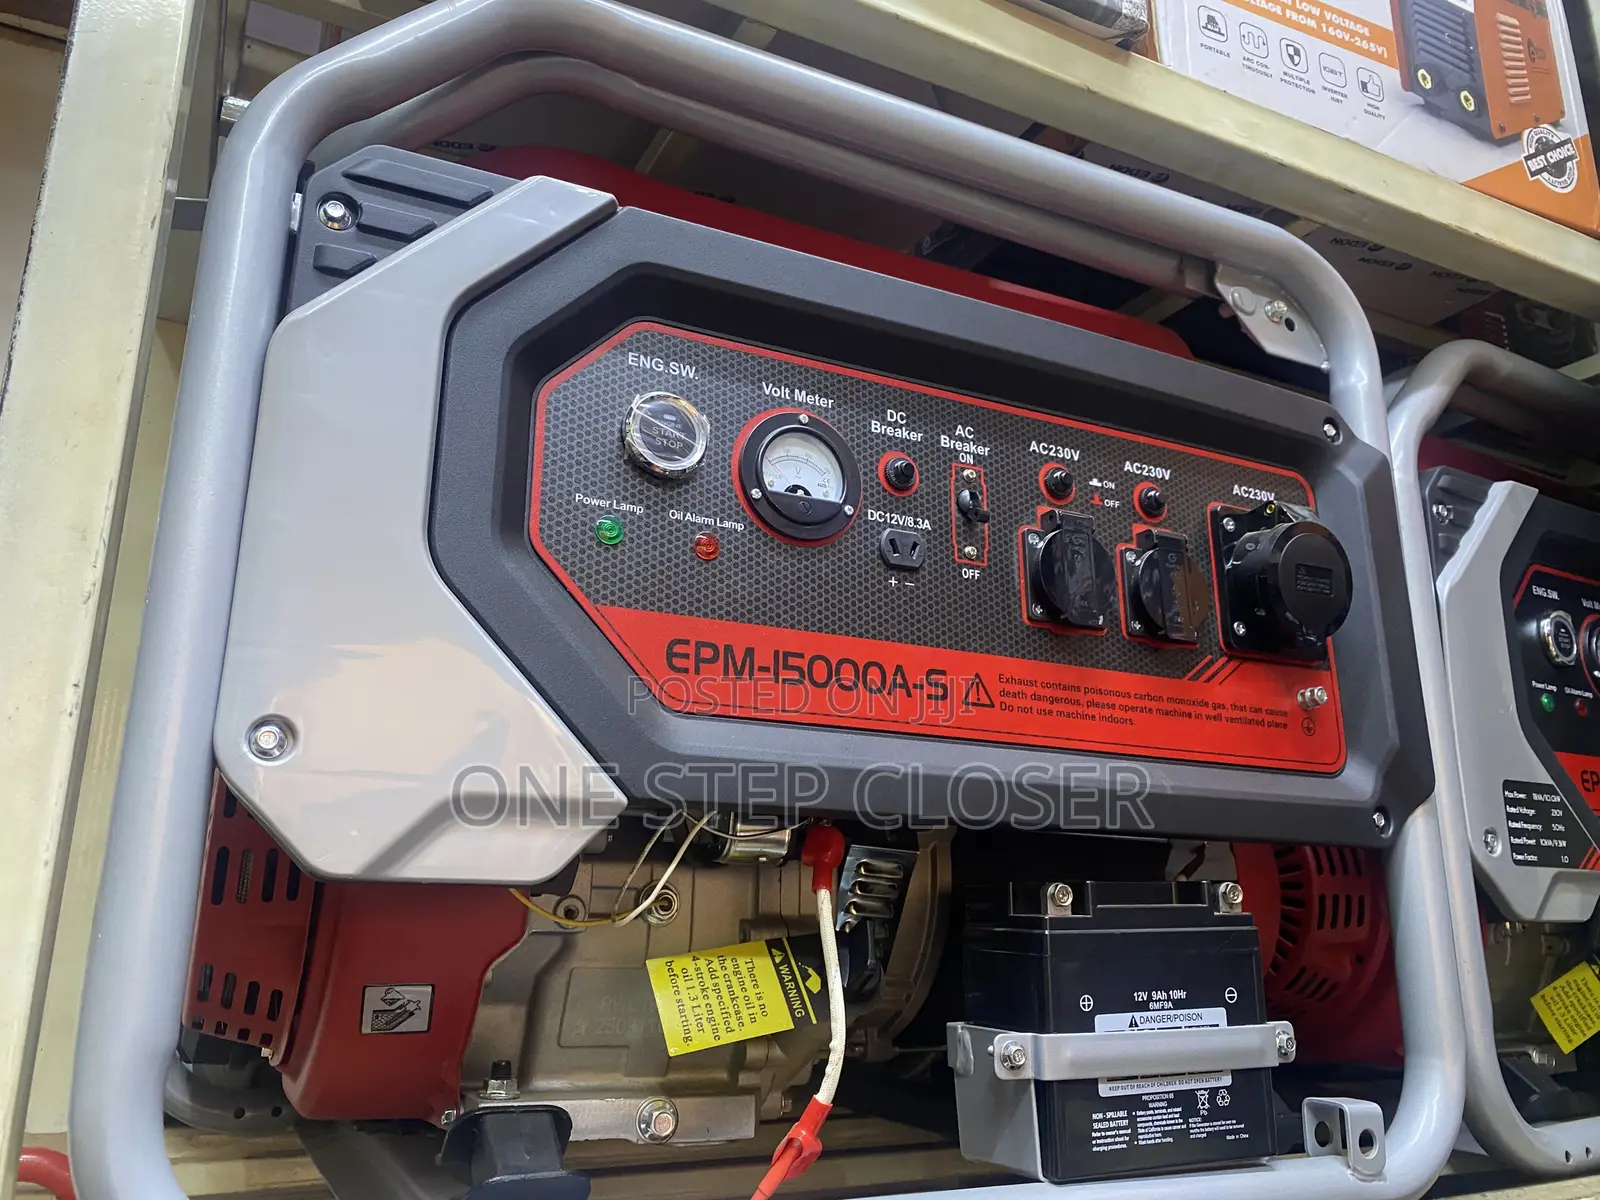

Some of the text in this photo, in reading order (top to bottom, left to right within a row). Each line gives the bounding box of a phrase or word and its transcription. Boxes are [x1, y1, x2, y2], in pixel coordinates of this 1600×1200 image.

[1286, 8, 1317, 29] FROM
[1296, 0, 1370, 36] LOW VOLTAGE
[1200, 43, 1231, 58] PORTABLE
[1280, 77, 1316, 94] PROTECTION
[1283, 71, 1310, 85] MULTIPLE
[1527, 143, 1575, 172] BEST CHOICE
[628, 352, 699, 380] ENG.SW.
[762, 382, 835, 409] Volt Meter
[887, 409, 907, 424] DC
[652, 426, 688, 440] START
[871, 420, 923, 442] Breaker
[955, 424, 974, 439] AC
[655, 437, 683, 449] STOP
[940, 435, 990, 456] Breaker
[1029, 440, 1080, 462] AC230V
[959, 452, 974, 465] ON
[1123, 461, 1171, 480] AC230V
[1102, 481, 1115, 490] ON
[1232, 484, 1275, 502] AC230V
[575, 493, 644, 515] Power Lamp
[1104, 499, 1120, 509] OFF
[669, 509, 745, 532] Oil Alarm Lamp
[867, 509, 932, 531] DC12V/8.3A
[961, 567, 981, 580] OFF
[665, 638, 948, 702] EPM-15000A-S
[998, 673, 1288, 717] Exhaust contains poisonous carbon monoxide gas, that can cause
[999, 688, 1288, 730] death dangerous, please operate machine in well ventilated place
[1000, 701, 1136, 726] Do not use machine indoors.
[1552, 823, 1565, 832] 50Hz
[692, 955, 721, 1041] 4-stroke engine
[705, 958, 735, 1034] Add specified
[717, 955, 745, 1031] the crankcase.
[731, 957, 758, 1024] engine oil in
[744, 958, 769, 1017] There is no
[778, 964, 805, 1018] WARNING
[1133, 989, 1187, 1001] 12V 9Ah 10Hr
[665, 960, 693, 1047] before starting.
[681, 967, 705, 1034] oil 1.3 Liter
[1149, 1001, 1173, 1010] 6MF9A
[1140, 1013, 1203, 1025] DANGER/POISON
[1142, 1093, 1168, 1101] PROPOSITION
[1092, 1121, 1109, 1130] SEALED
[1110, 1119, 1129, 1128] BATTERY
[1106, 1110, 1128, 1118] SPILLABLE
